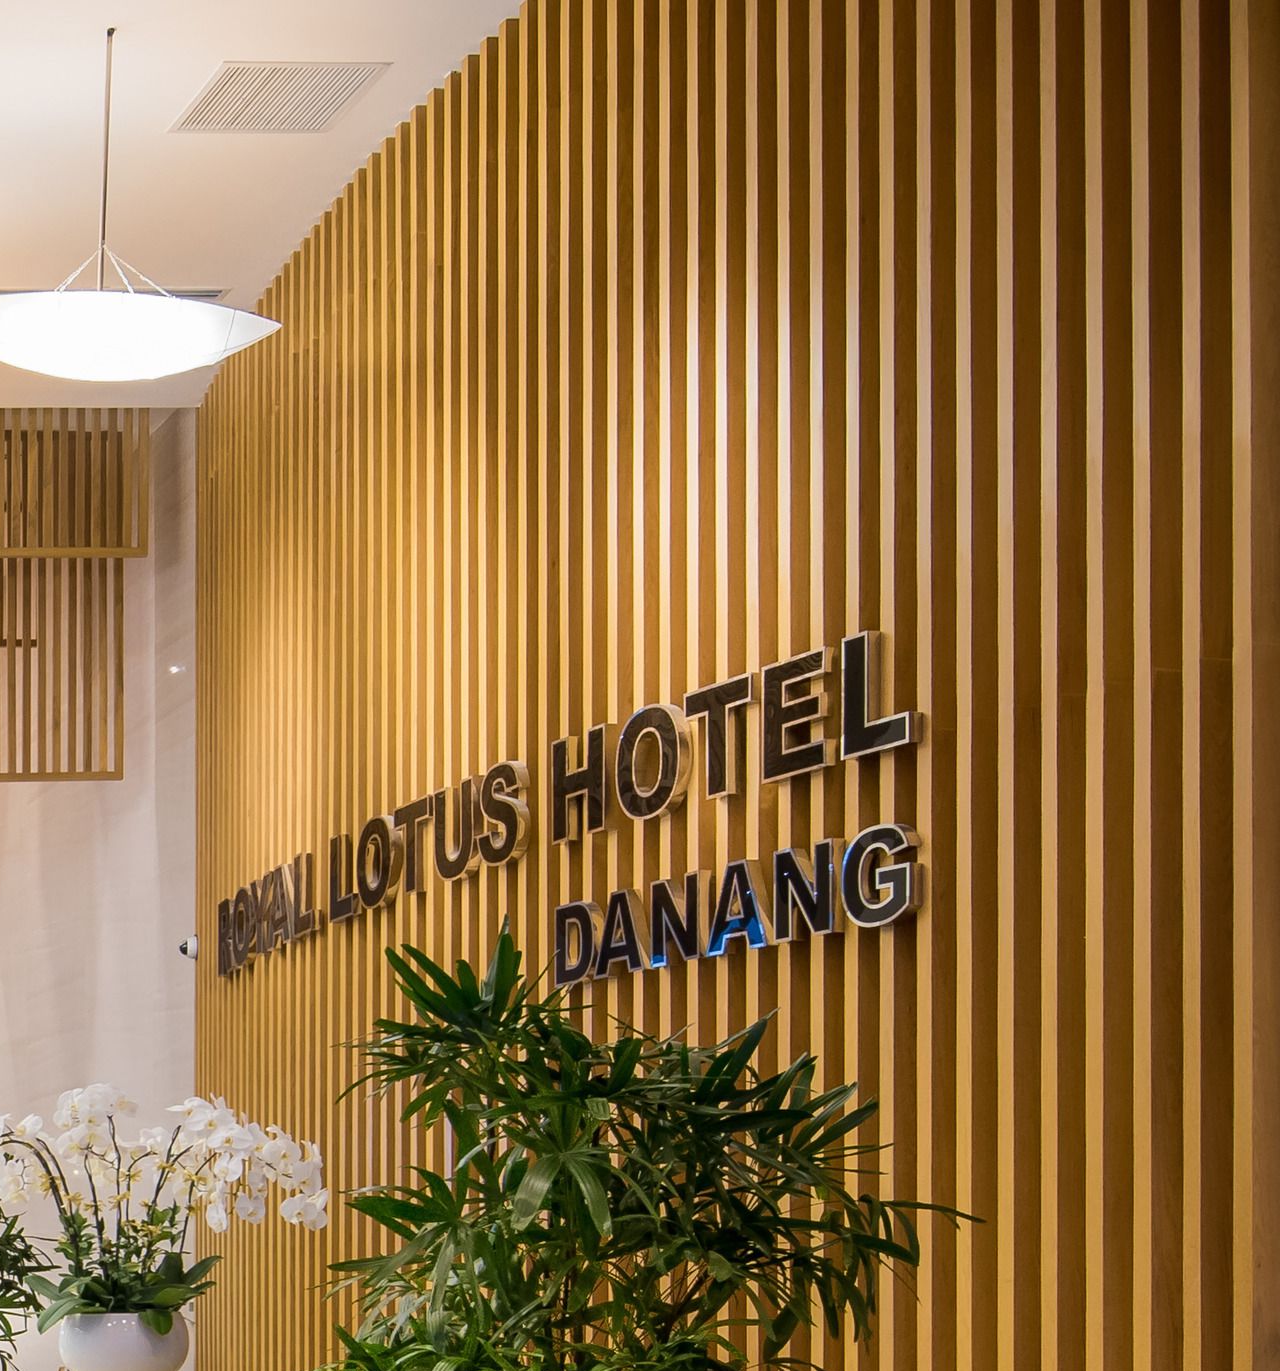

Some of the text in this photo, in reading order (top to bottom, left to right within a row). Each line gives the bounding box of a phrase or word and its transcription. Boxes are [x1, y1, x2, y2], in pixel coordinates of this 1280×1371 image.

[218, 630, 923, 977] ROYAL LOTUS HOTEL
[554, 823, 923, 988] DANANG
